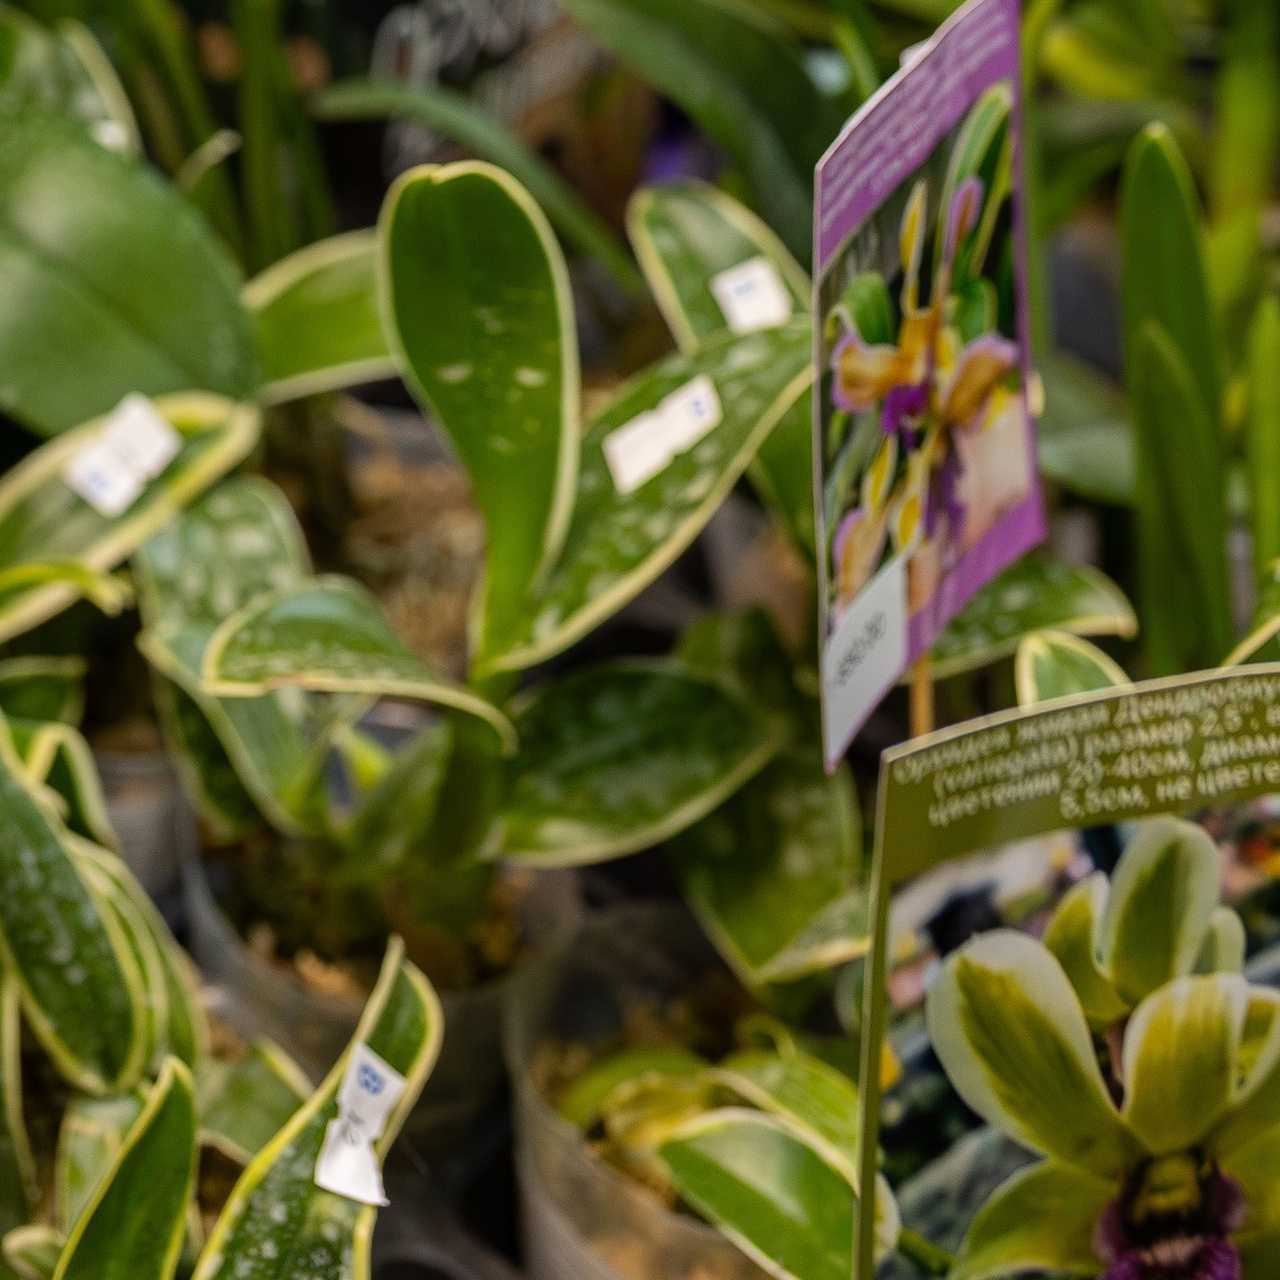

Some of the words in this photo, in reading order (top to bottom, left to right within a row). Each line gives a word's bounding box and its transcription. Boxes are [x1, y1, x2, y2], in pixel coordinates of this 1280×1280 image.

[1113, 679, 1280, 727] Дендробиу
[1085, 717, 1194, 761] размер
[1155, 775, 1193, 803] не
